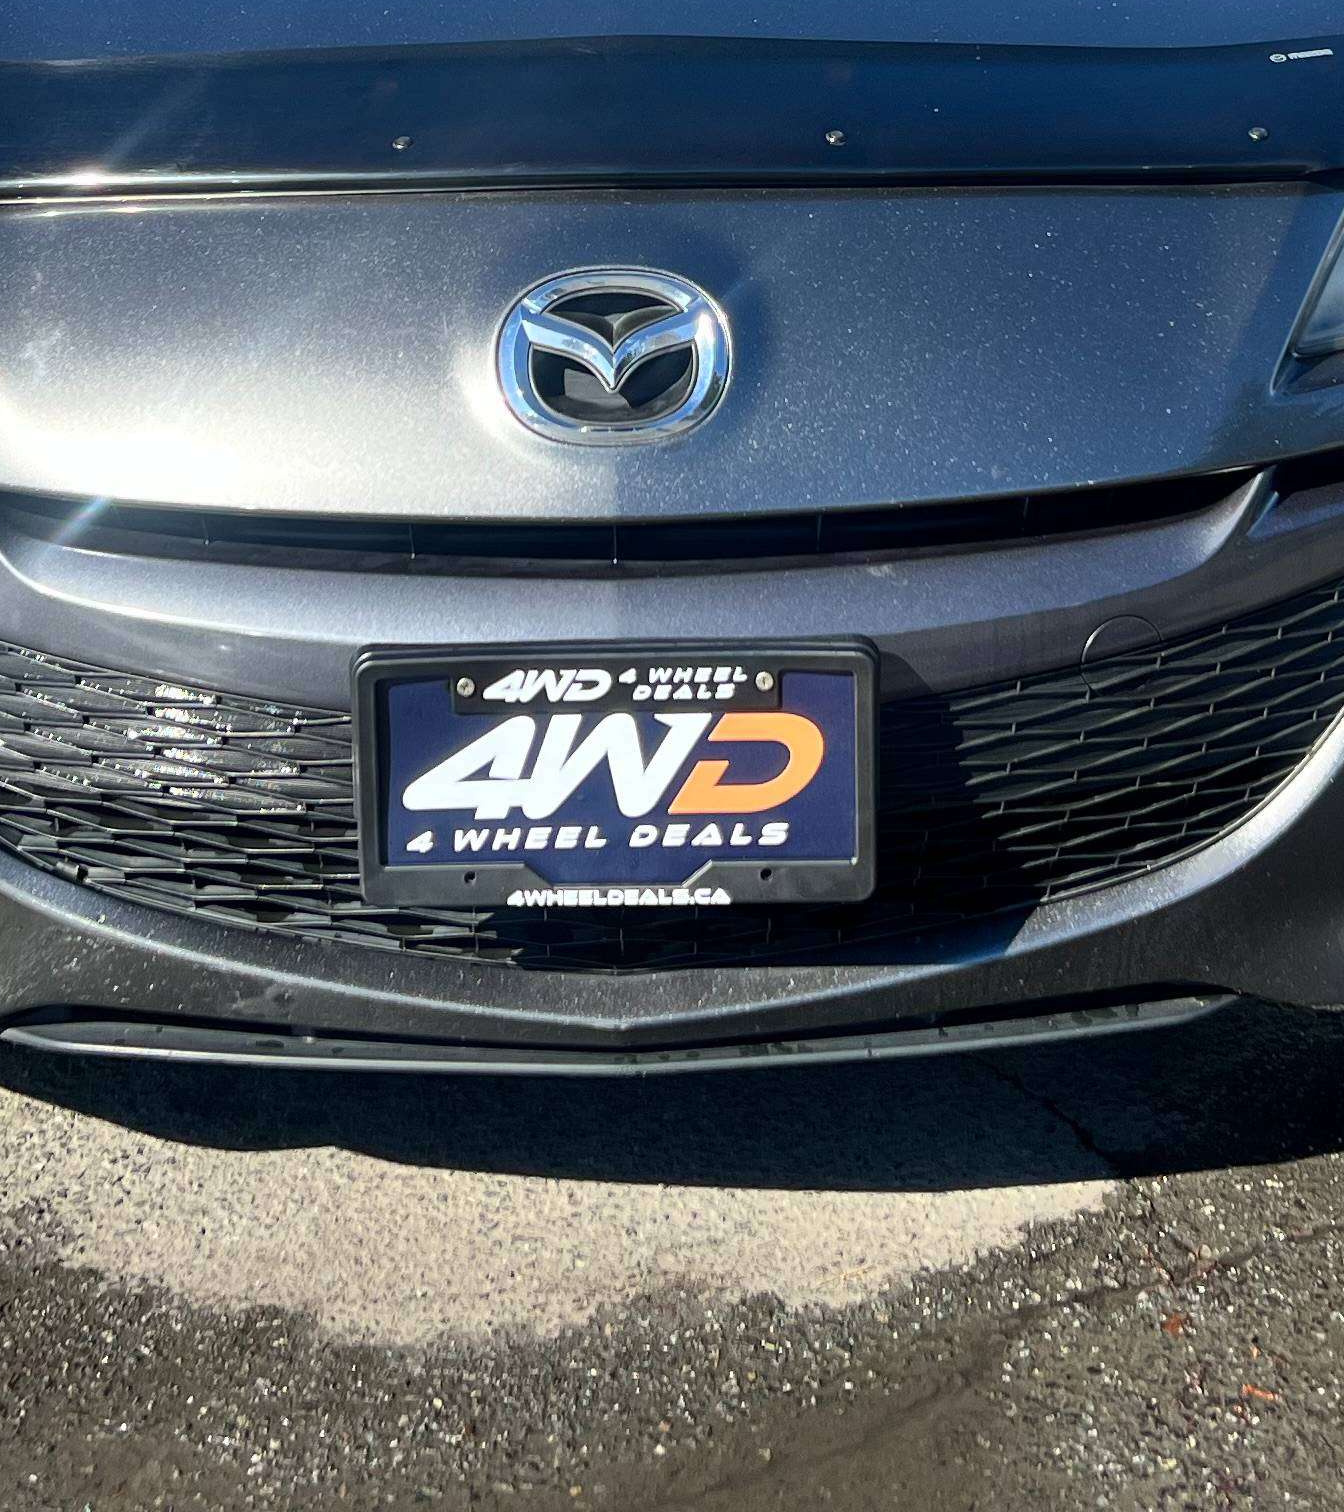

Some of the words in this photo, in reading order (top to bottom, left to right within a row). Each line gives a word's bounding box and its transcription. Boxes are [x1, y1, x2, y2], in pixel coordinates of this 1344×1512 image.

[483, 669, 612, 703] 4WD
[618, 667, 637, 684] 4
[649, 666, 748, 684] WHEEL
[633, 683, 736, 701] DEALS
[402, 712, 824, 820] 4WD
[406, 830, 434, 853] 4
[454, 825, 608, 852] WHEEL
[629, 822, 790, 848] DEALS
[506, 887, 732, 907] 4WHEELDEALS.CA
